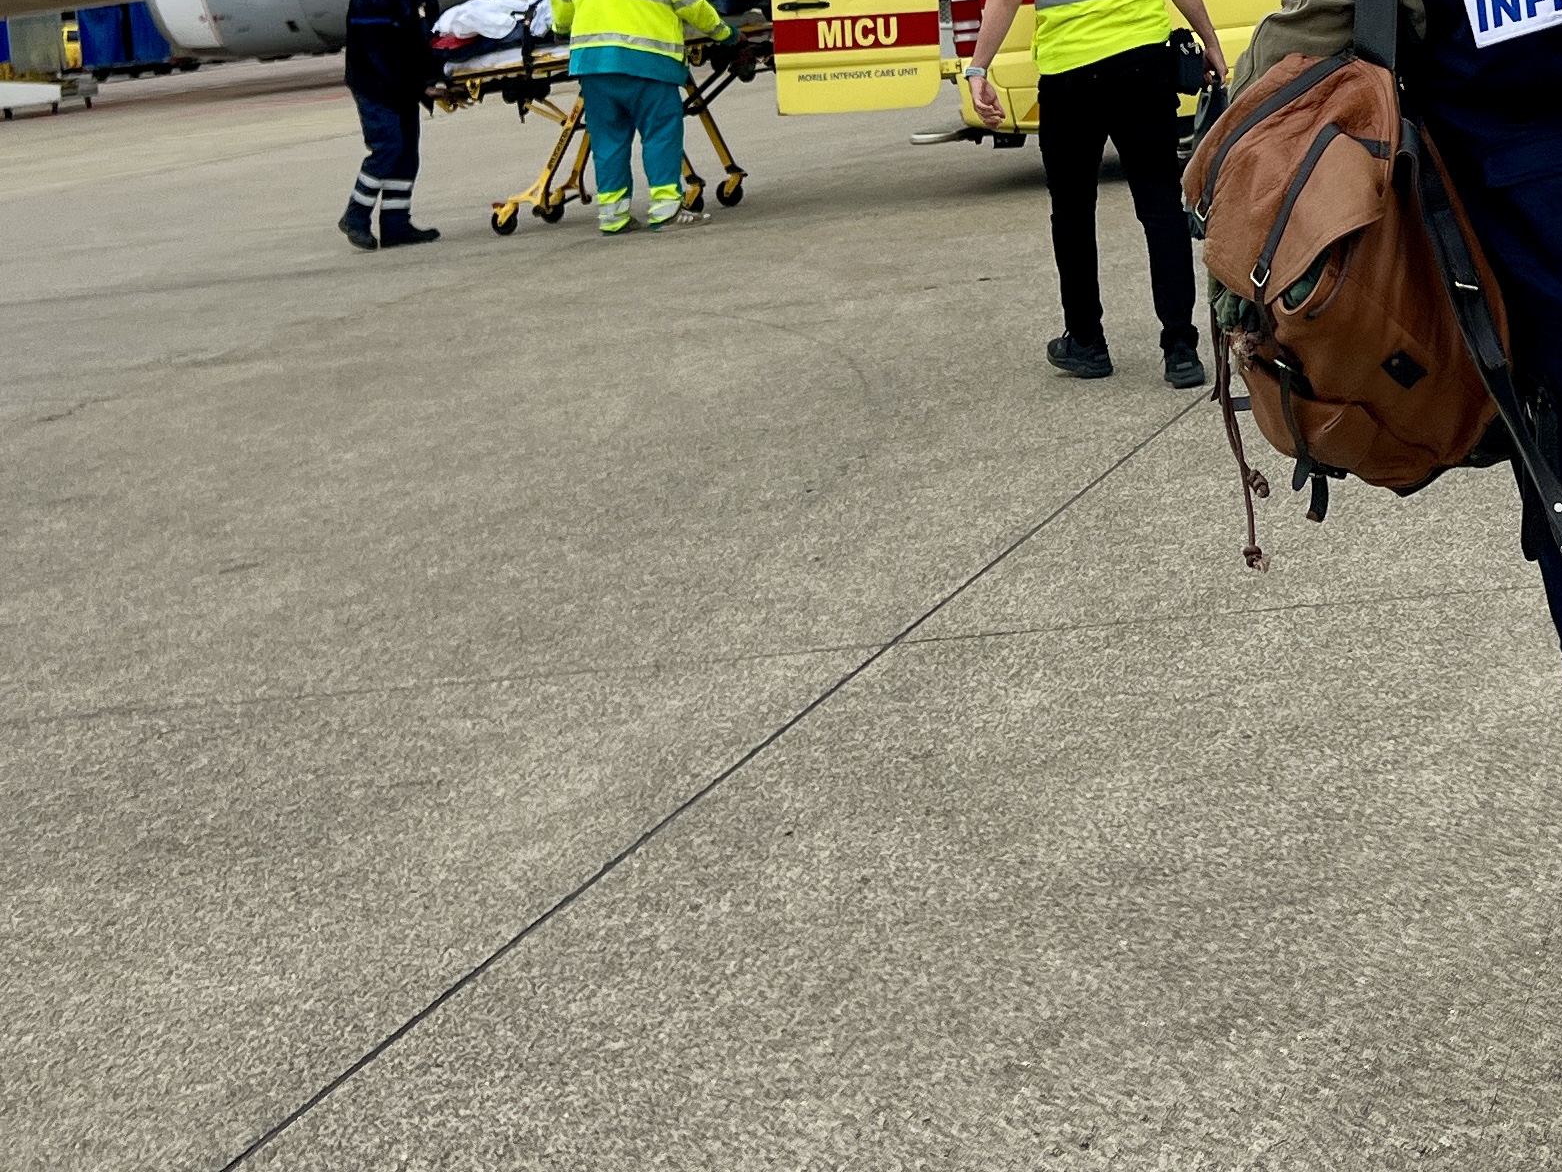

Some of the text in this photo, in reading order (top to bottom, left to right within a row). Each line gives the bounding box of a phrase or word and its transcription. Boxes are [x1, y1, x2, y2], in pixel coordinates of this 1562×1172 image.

[817, 16, 898, 49] MICU
[830, 69, 873, 81] INTENSIVE
[874, 69, 896, 79] CARE
[898, 67, 919, 77] UNIT
